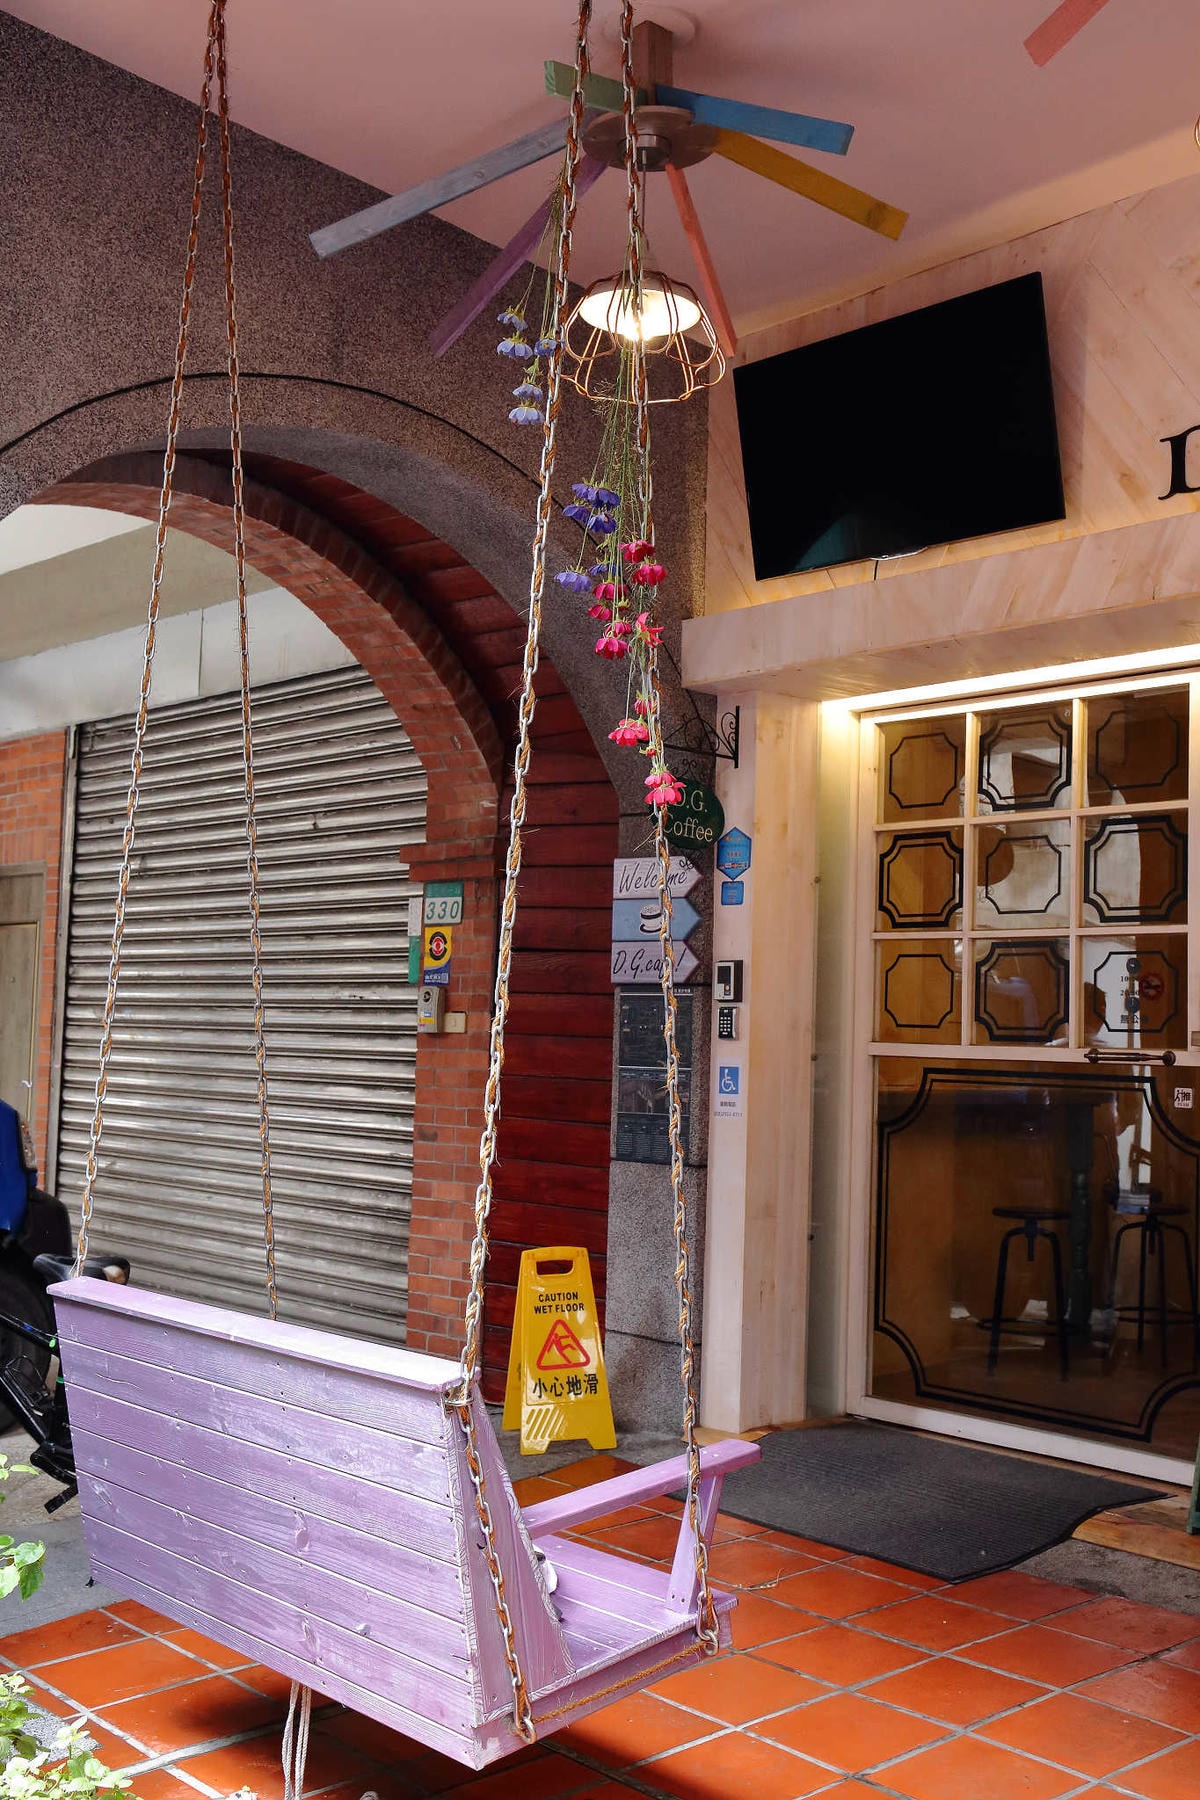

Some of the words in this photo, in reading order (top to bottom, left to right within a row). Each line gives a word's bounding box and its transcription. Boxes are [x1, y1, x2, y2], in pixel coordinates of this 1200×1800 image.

[664, 813, 713, 842] Coffee
[619, 862, 687, 893] Welcme
[426, 901, 460, 921] 330
[534, 1304, 552, 1314] WET
[555, 1302, 585, 1313] FLOOR
[538, 1292, 579, 1302] CAUTION
[532, 1374, 599, 1398] 小心地滑
